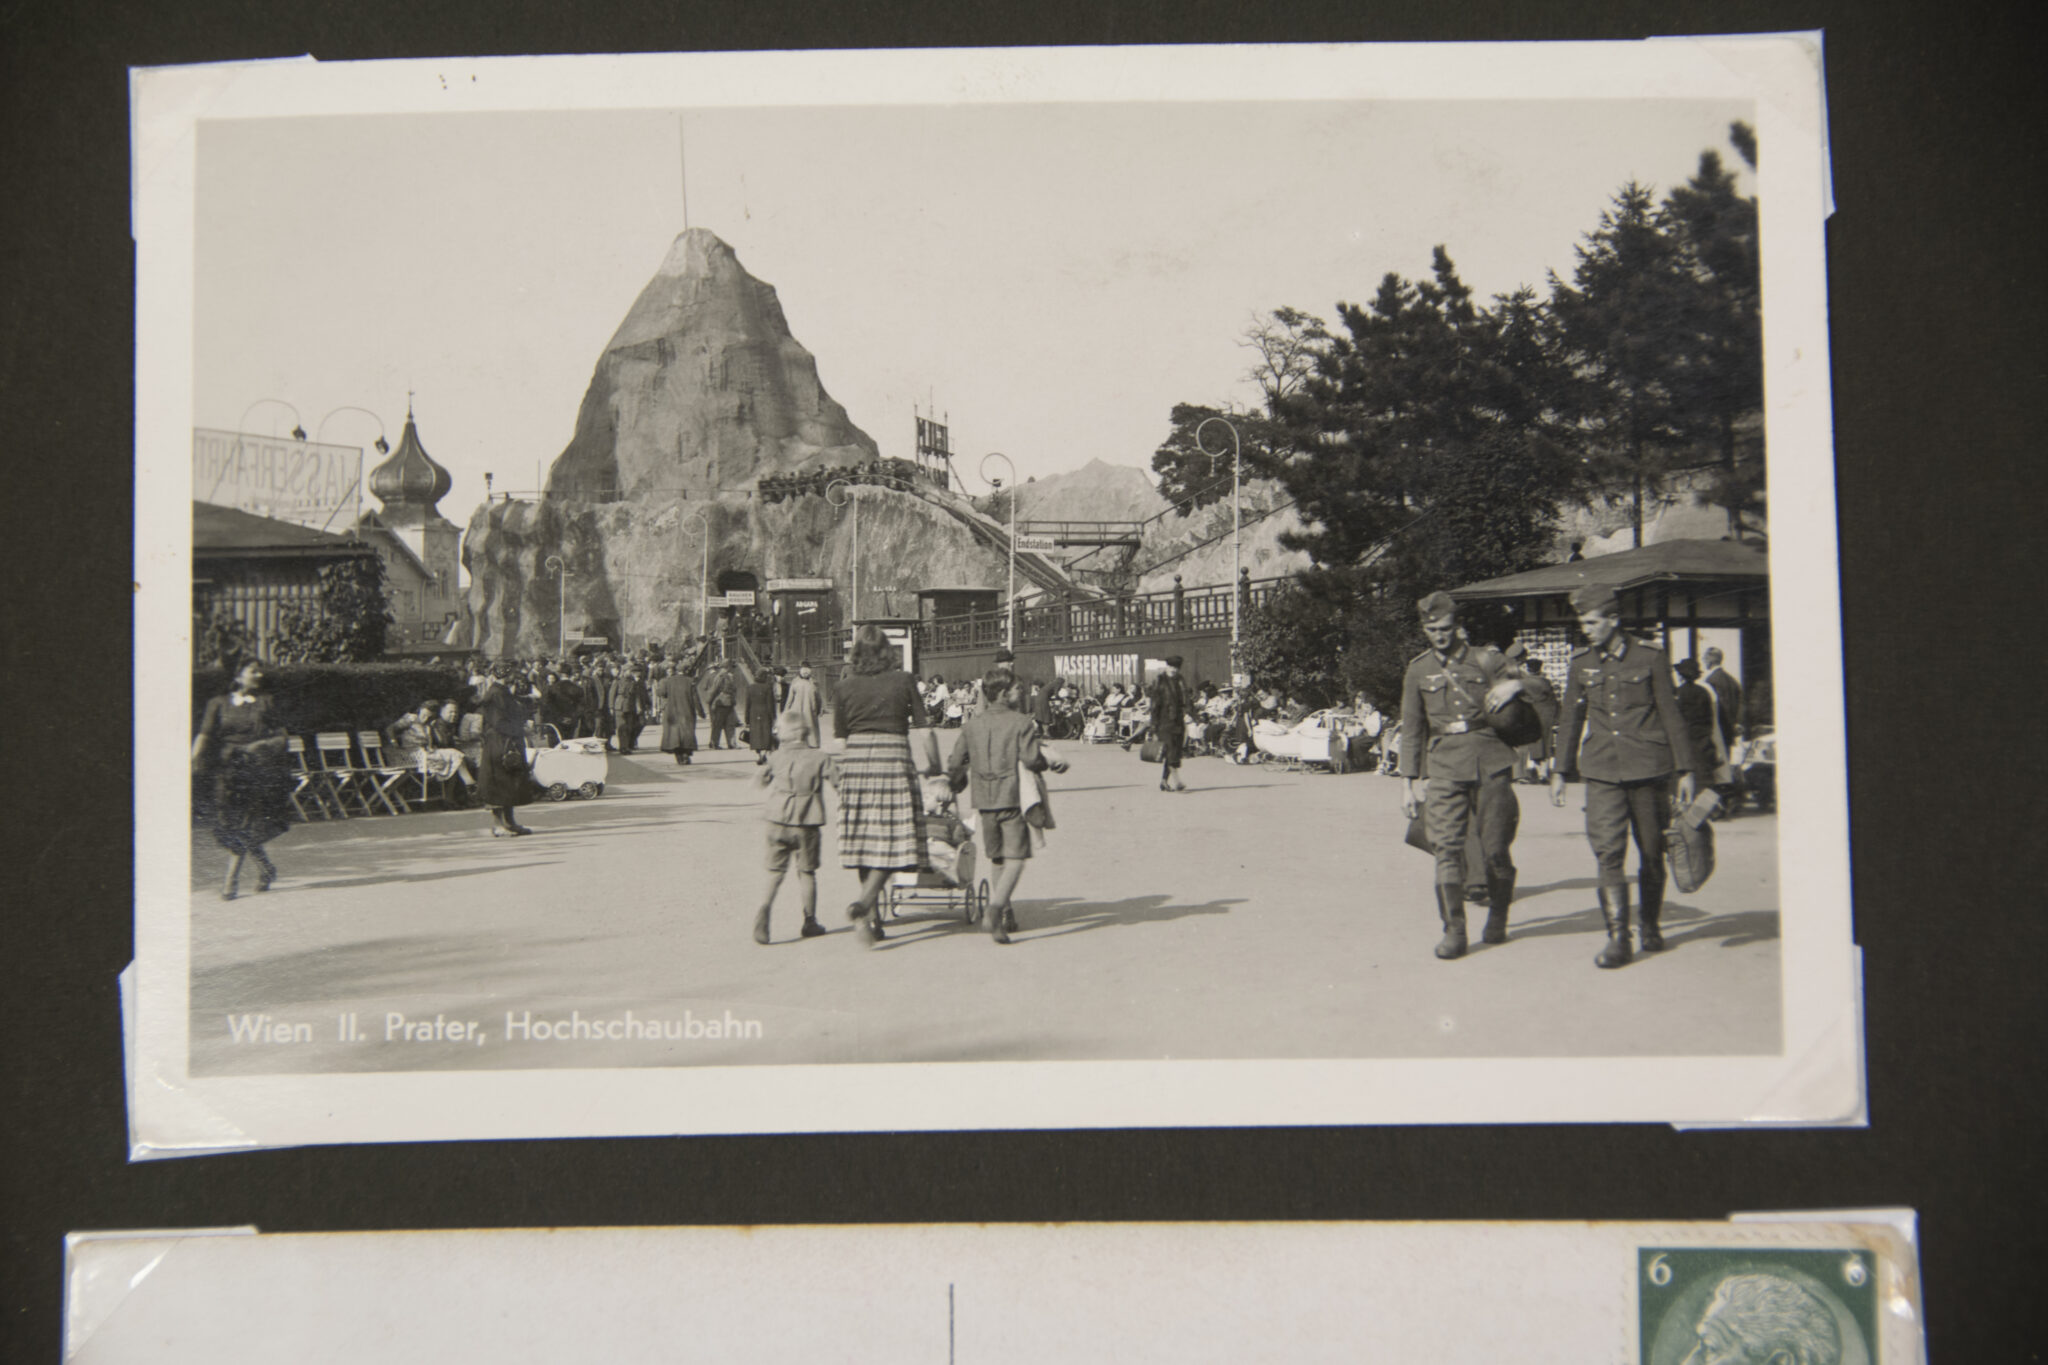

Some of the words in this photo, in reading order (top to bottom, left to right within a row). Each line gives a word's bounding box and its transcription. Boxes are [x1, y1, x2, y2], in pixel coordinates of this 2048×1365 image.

[1054, 653, 1139, 676] WASSERFAHRT
[227, 1013, 313, 1044] Wien
[385, 1012, 487, 1046] Prater,
[505, 1010, 763, 1041] Hochschaubahn
[1649, 1253, 1672, 1286] 6
